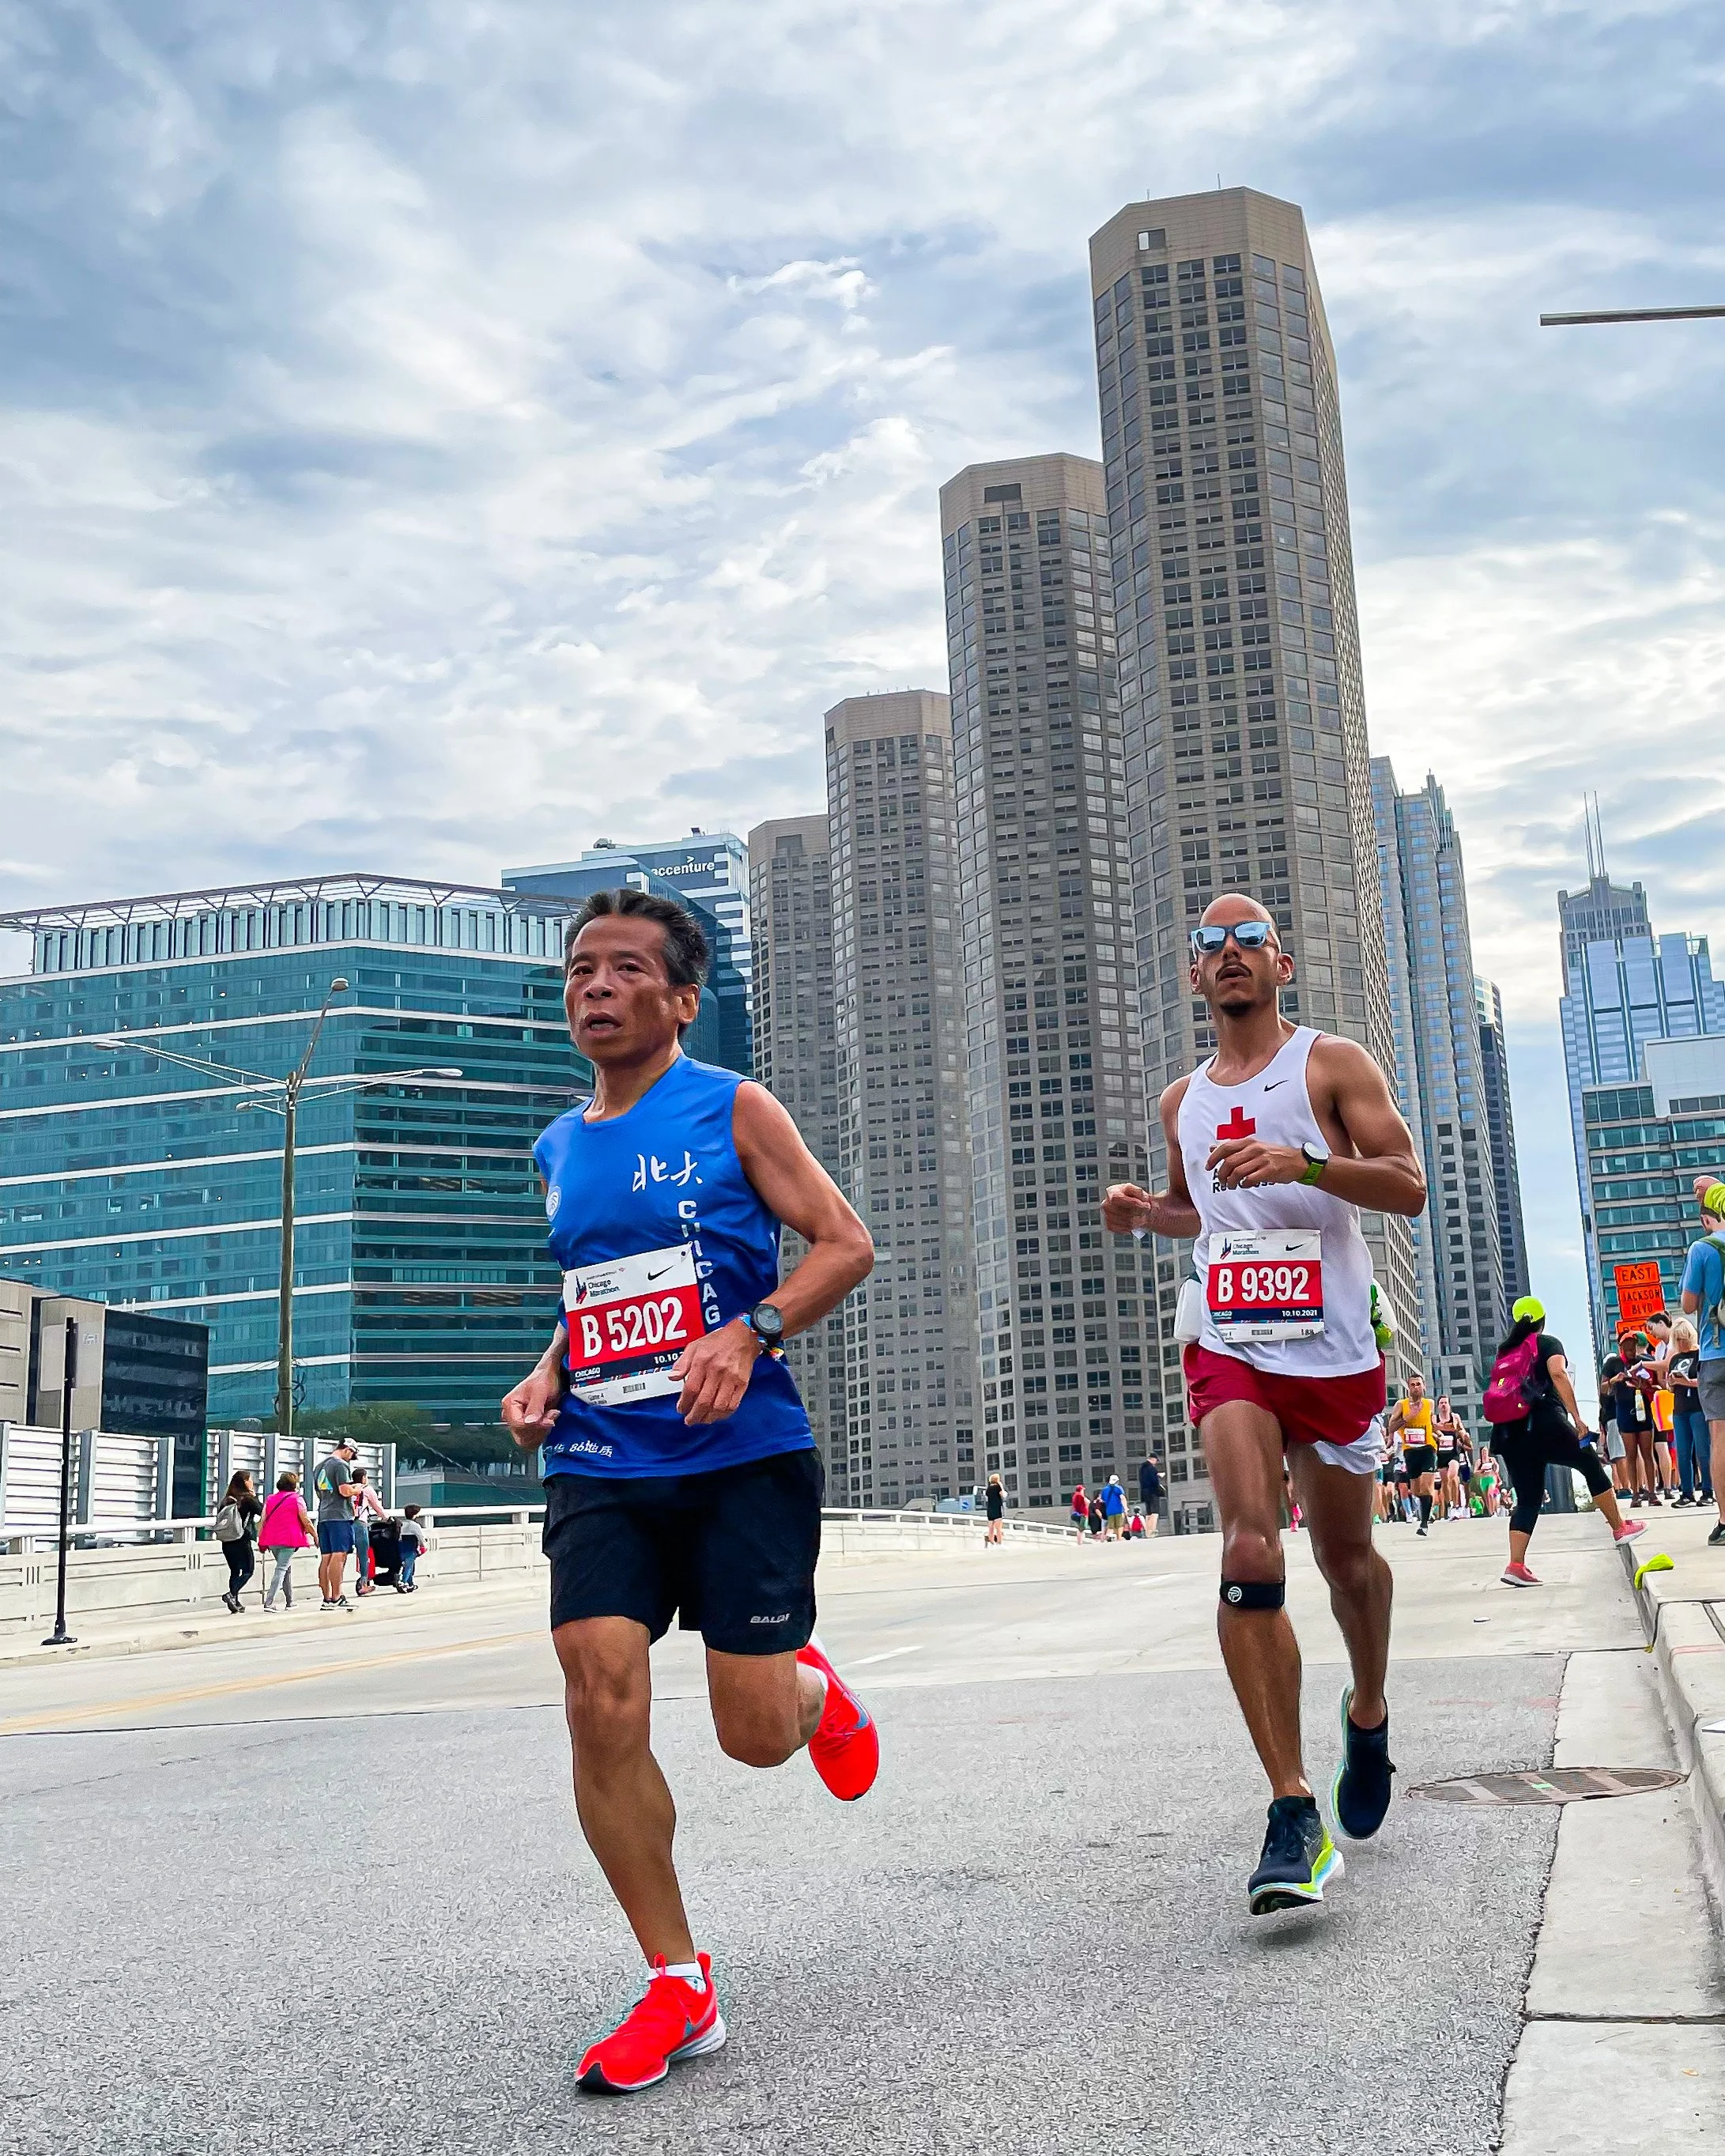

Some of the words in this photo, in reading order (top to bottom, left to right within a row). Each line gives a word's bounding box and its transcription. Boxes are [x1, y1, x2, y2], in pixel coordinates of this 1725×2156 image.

[651, 862, 715, 877] accenture
[632, 1151, 703, 1191] 北大
[1621, 1267, 1651, 1282] EAST
[1217, 1268, 1233, 1303] B
[1241, 1267, 1309, 1302] 9392
[1623, 1289, 1659, 1302] JACKSON
[1632, 1303, 1653, 1314] BLVD
[580, 1314, 602, 1358] B
[606, 1297, 687, 1352] 5202
